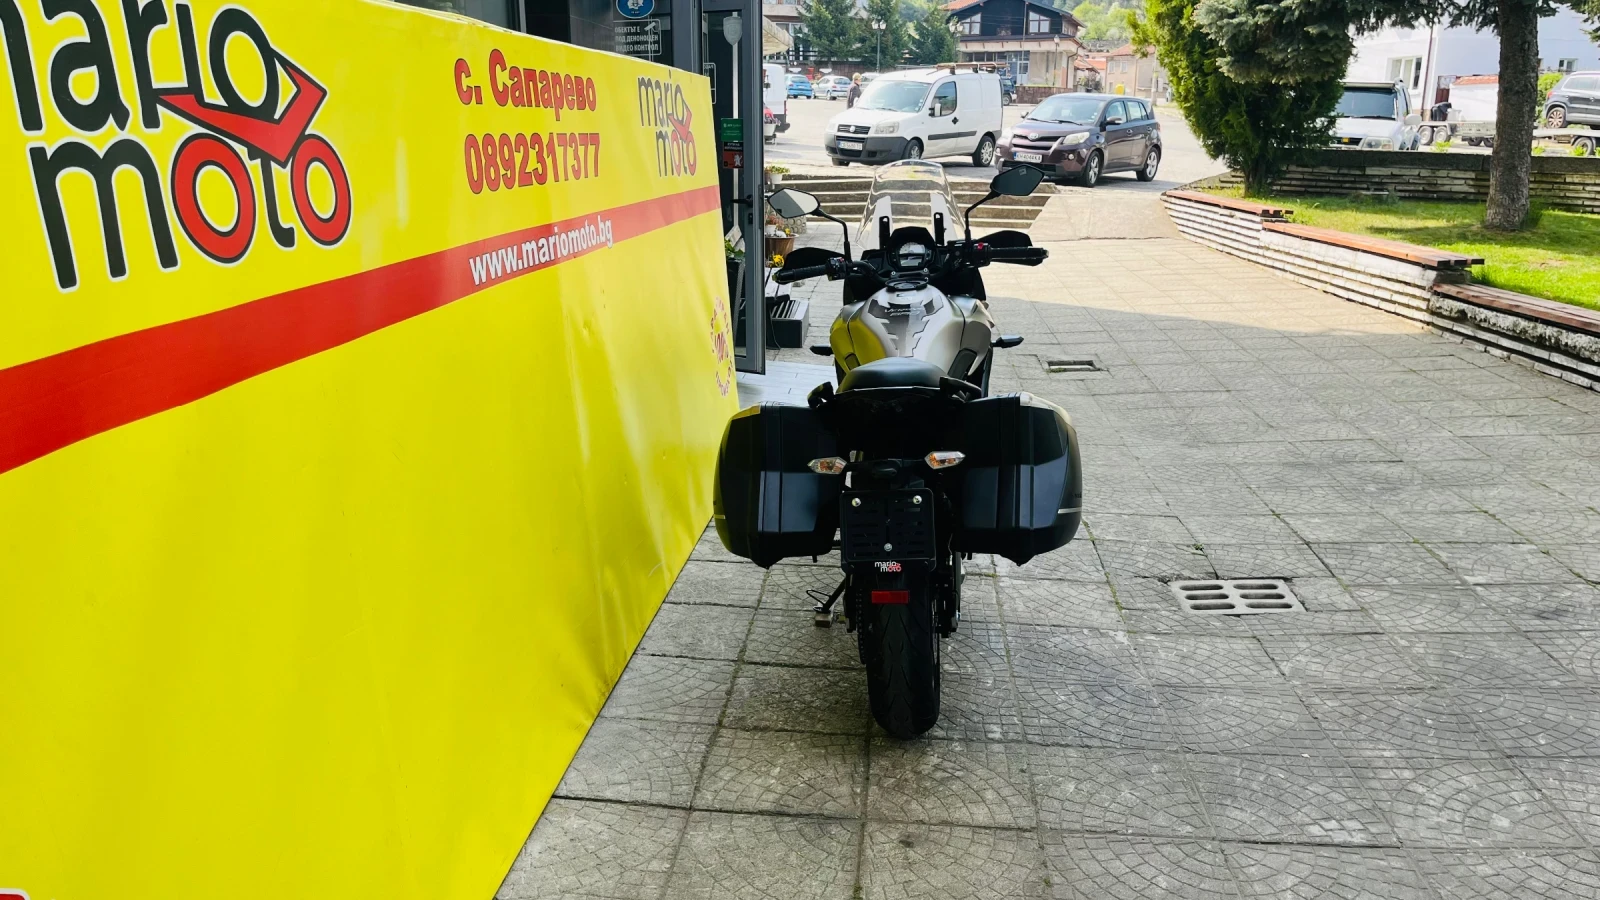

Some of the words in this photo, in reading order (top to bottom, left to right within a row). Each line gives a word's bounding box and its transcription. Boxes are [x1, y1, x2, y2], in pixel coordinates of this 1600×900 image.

[633, 43, 659, 51] КОНТРОЛ
[488, 48, 597, 122] Сапарево
[637, 69, 685, 127] mario
[464, 132, 600, 195] 0892317377
[656, 130, 697, 177] moto
[29, 133, 351, 290] moto
[468, 215, 614, 286] www.mariomoto.bg
